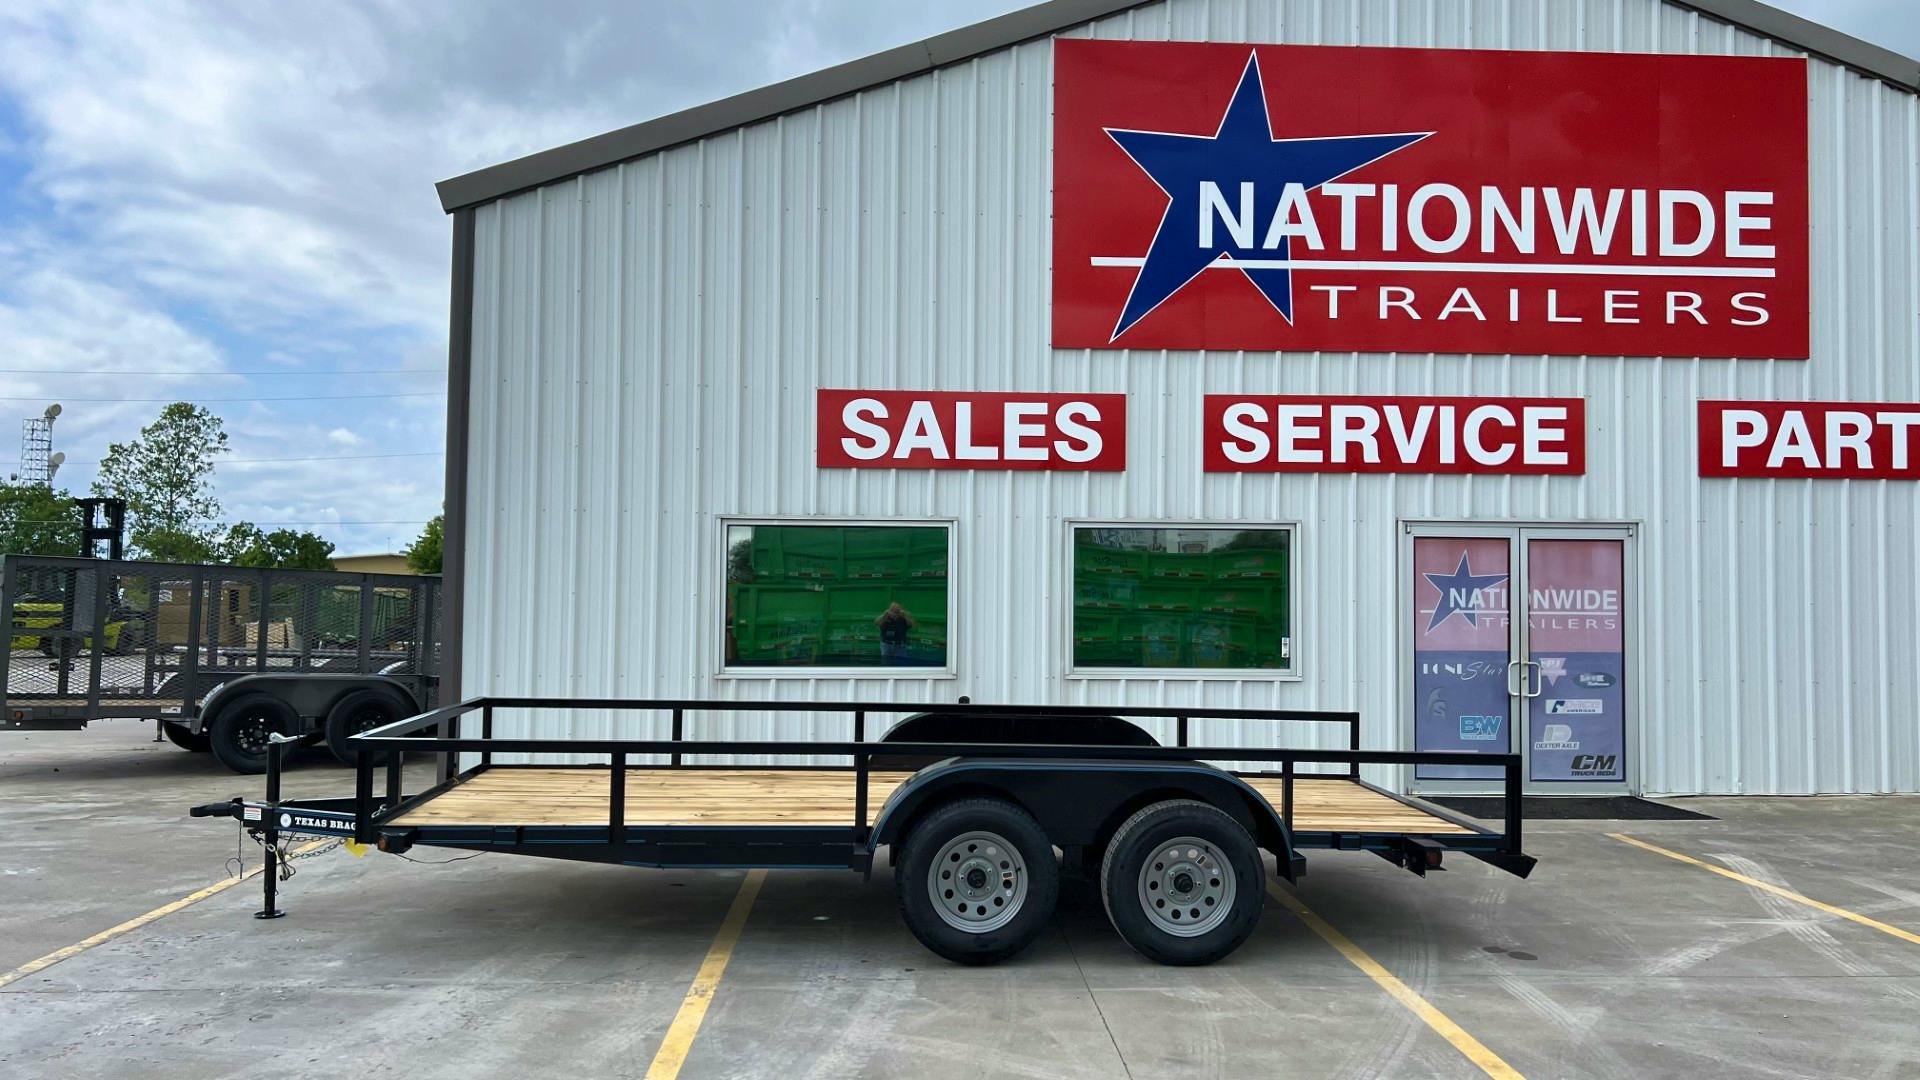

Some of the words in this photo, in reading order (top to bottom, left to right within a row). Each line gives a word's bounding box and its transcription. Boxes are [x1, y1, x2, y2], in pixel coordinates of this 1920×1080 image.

[1199, 181, 1776, 259] NATIONWIDE
[1310, 285, 1771, 327] TRAILERS
[841, 398, 1103, 463] SALES
[1221, 402, 1568, 466] SERVICE
[1721, 409, 1920, 470] PART
[1449, 587, 1618, 611] NATINWIDE
[1571, 755, 1616, 770] CM
[294, 816, 327, 828] TEXAS
